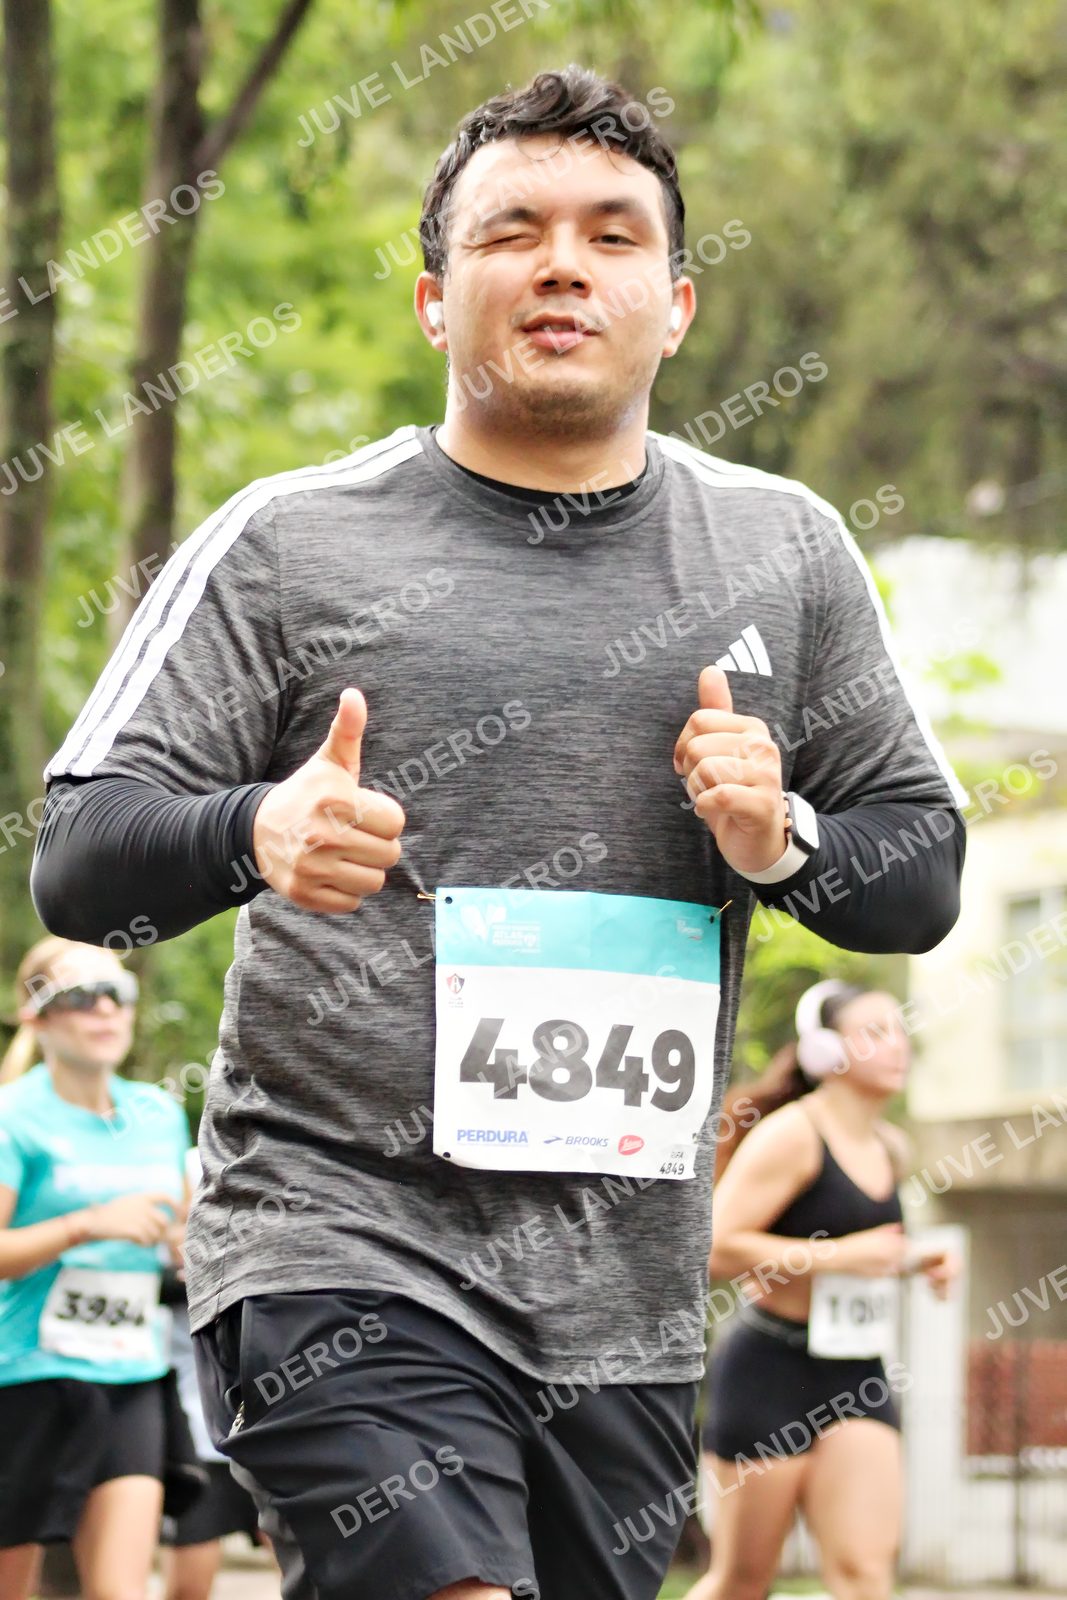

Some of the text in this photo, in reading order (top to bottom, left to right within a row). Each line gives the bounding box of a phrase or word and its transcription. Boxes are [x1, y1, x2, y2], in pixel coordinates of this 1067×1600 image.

[459, 1017, 696, 1113] 4849
[457, 1129, 529, 1144] PERDURA
[565, 1135, 609, 1148] BROOKS
[660, 1161, 685, 1176] 4849
